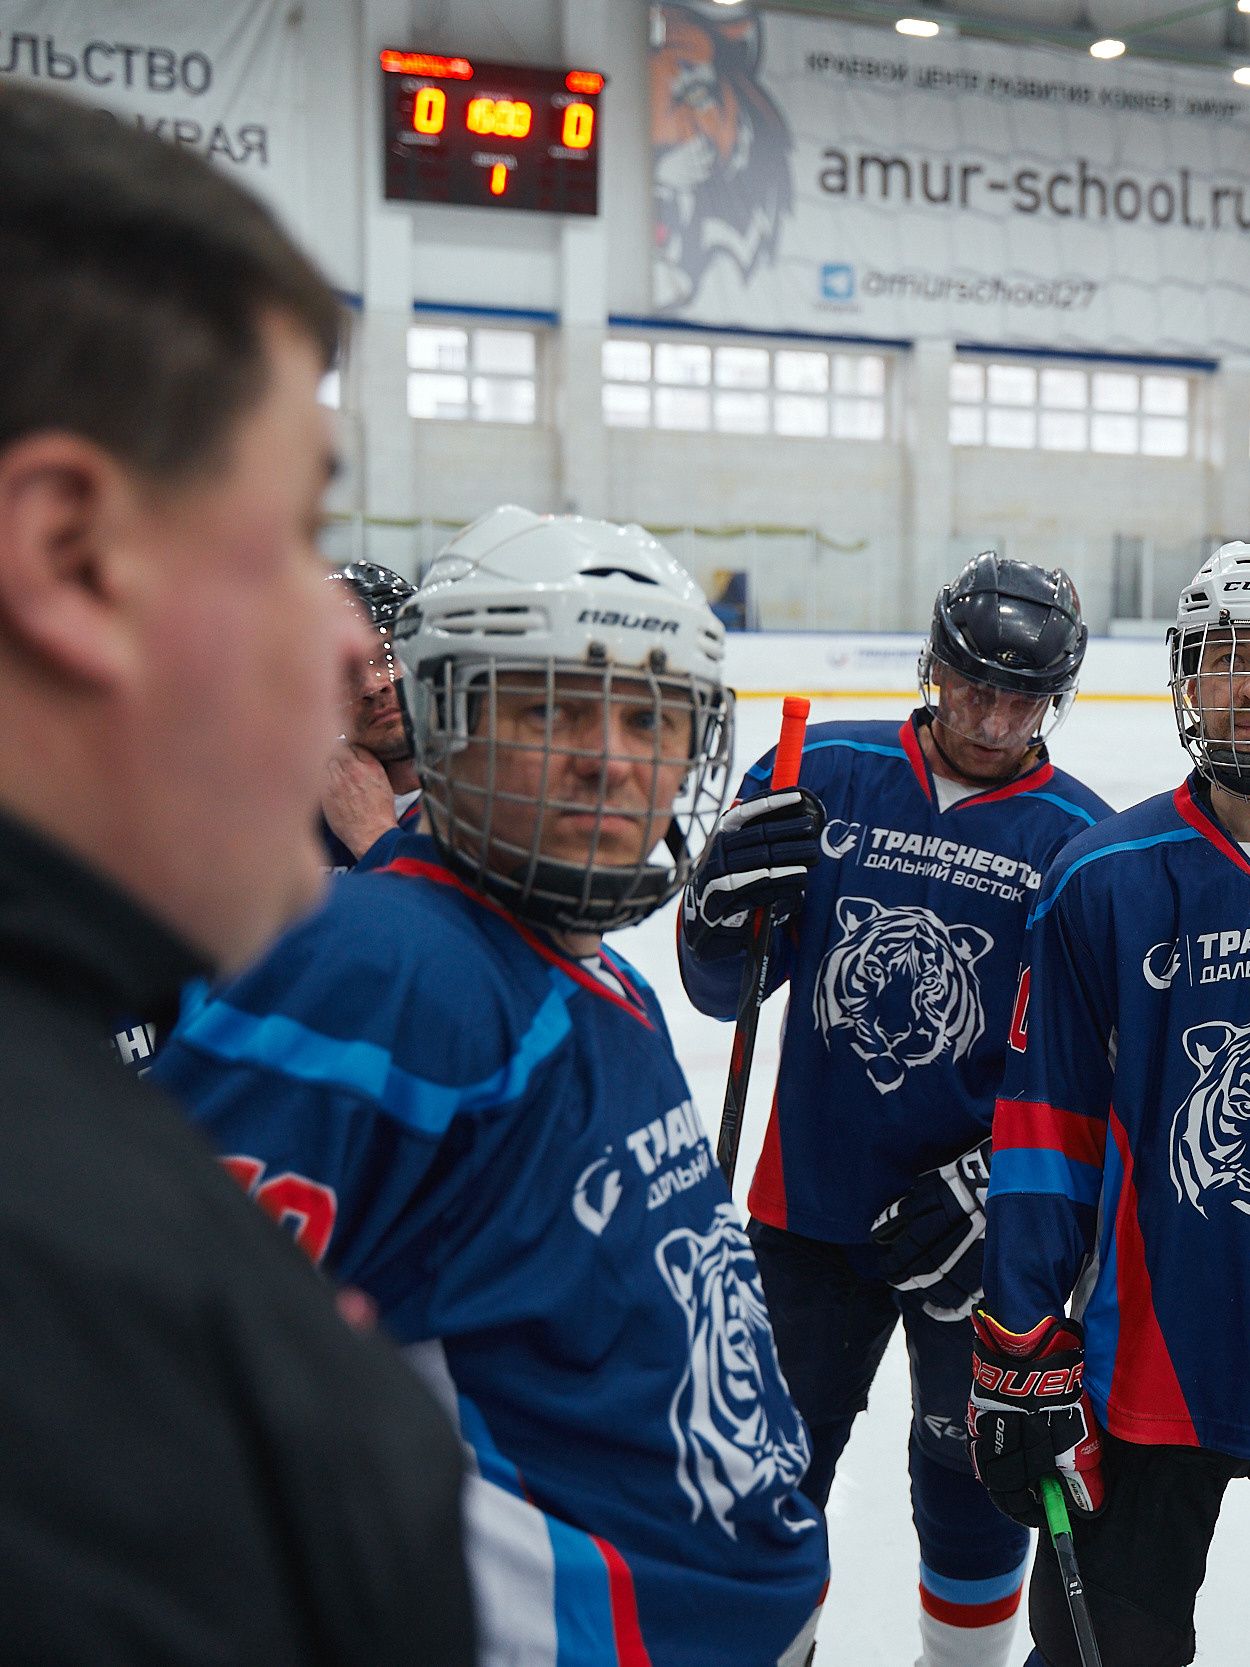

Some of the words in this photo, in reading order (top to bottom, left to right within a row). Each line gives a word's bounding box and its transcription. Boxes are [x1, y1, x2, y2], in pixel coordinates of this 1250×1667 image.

[413, 86, 446, 134] 0
[562, 102, 594, 149] 0
[490, 162, 507, 195] 1
[863, 853, 951, 882] ДАЛЬНИЙ
[951, 870, 1026, 904] ВОСТОК
[871, 827, 1042, 890] ТРАНСНЕФТЬ
